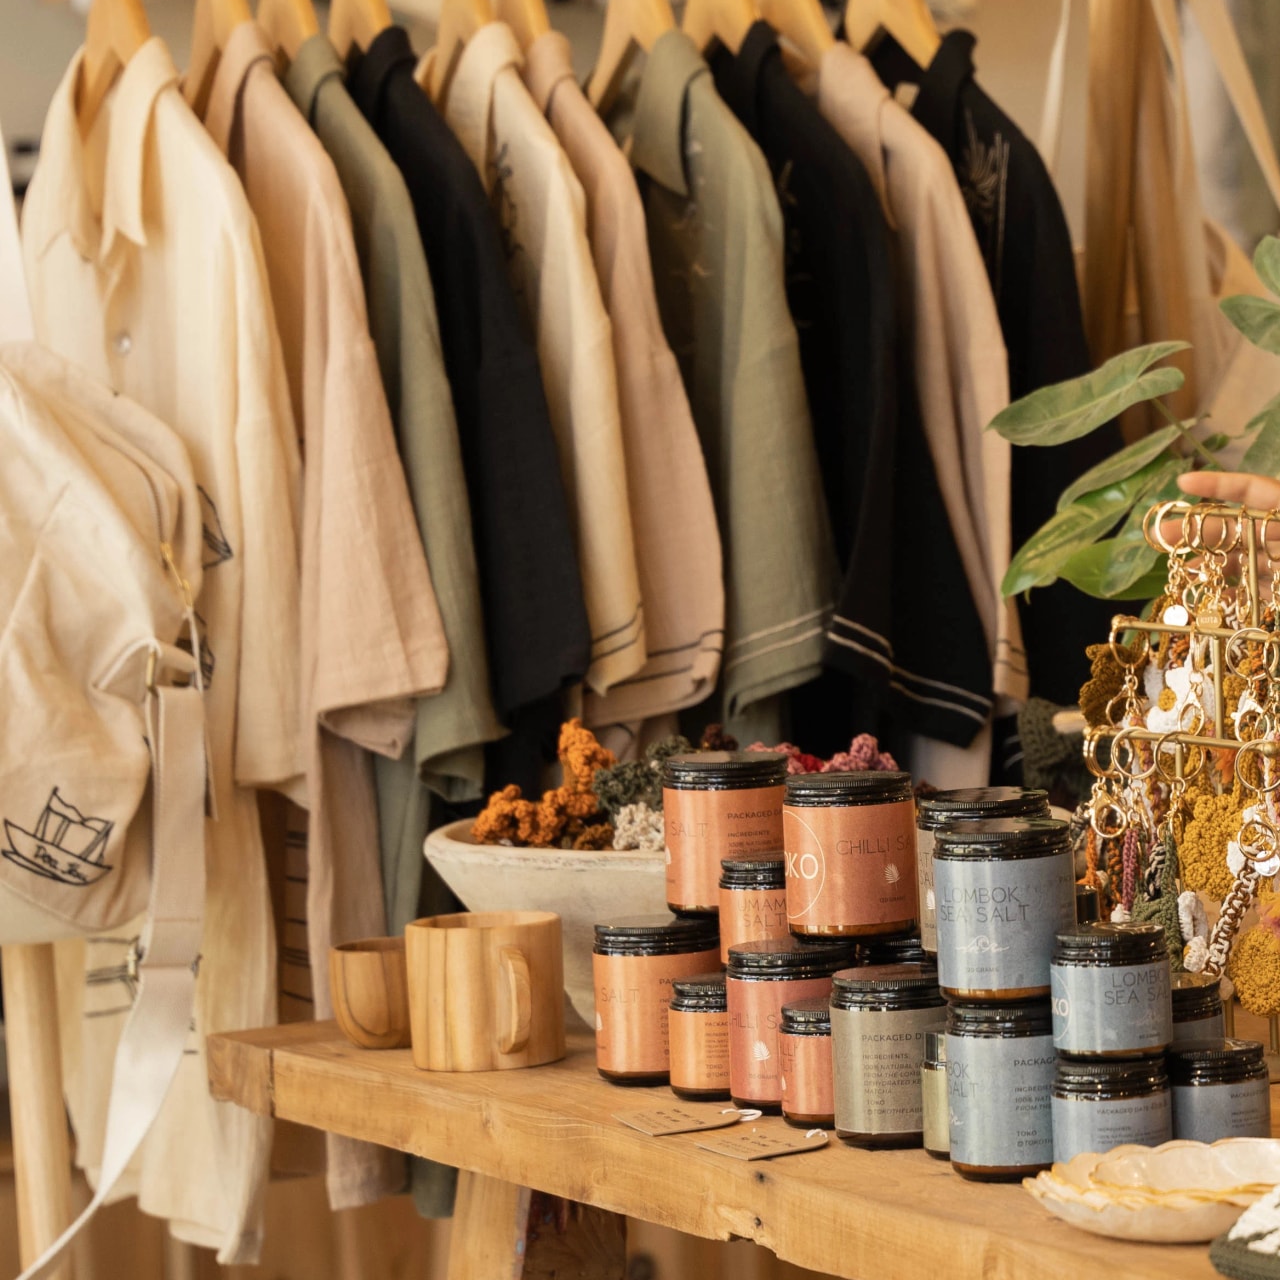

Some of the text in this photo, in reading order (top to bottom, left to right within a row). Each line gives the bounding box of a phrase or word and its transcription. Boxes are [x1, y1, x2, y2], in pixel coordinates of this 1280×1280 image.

[728, 809, 772, 819] PACKAGED
[671, 821, 708, 838] SALT
[836, 838, 890, 856] CHILLI
[944, 886, 1020, 904] LOMBOK
[743, 912, 786, 928] SALT
[940, 904, 1030, 923] SEA SALT
[601, 987, 639, 1003] SALT
[1104, 990, 1139, 1005] SEA
[861, 1033, 912, 1042] PACKAGED
